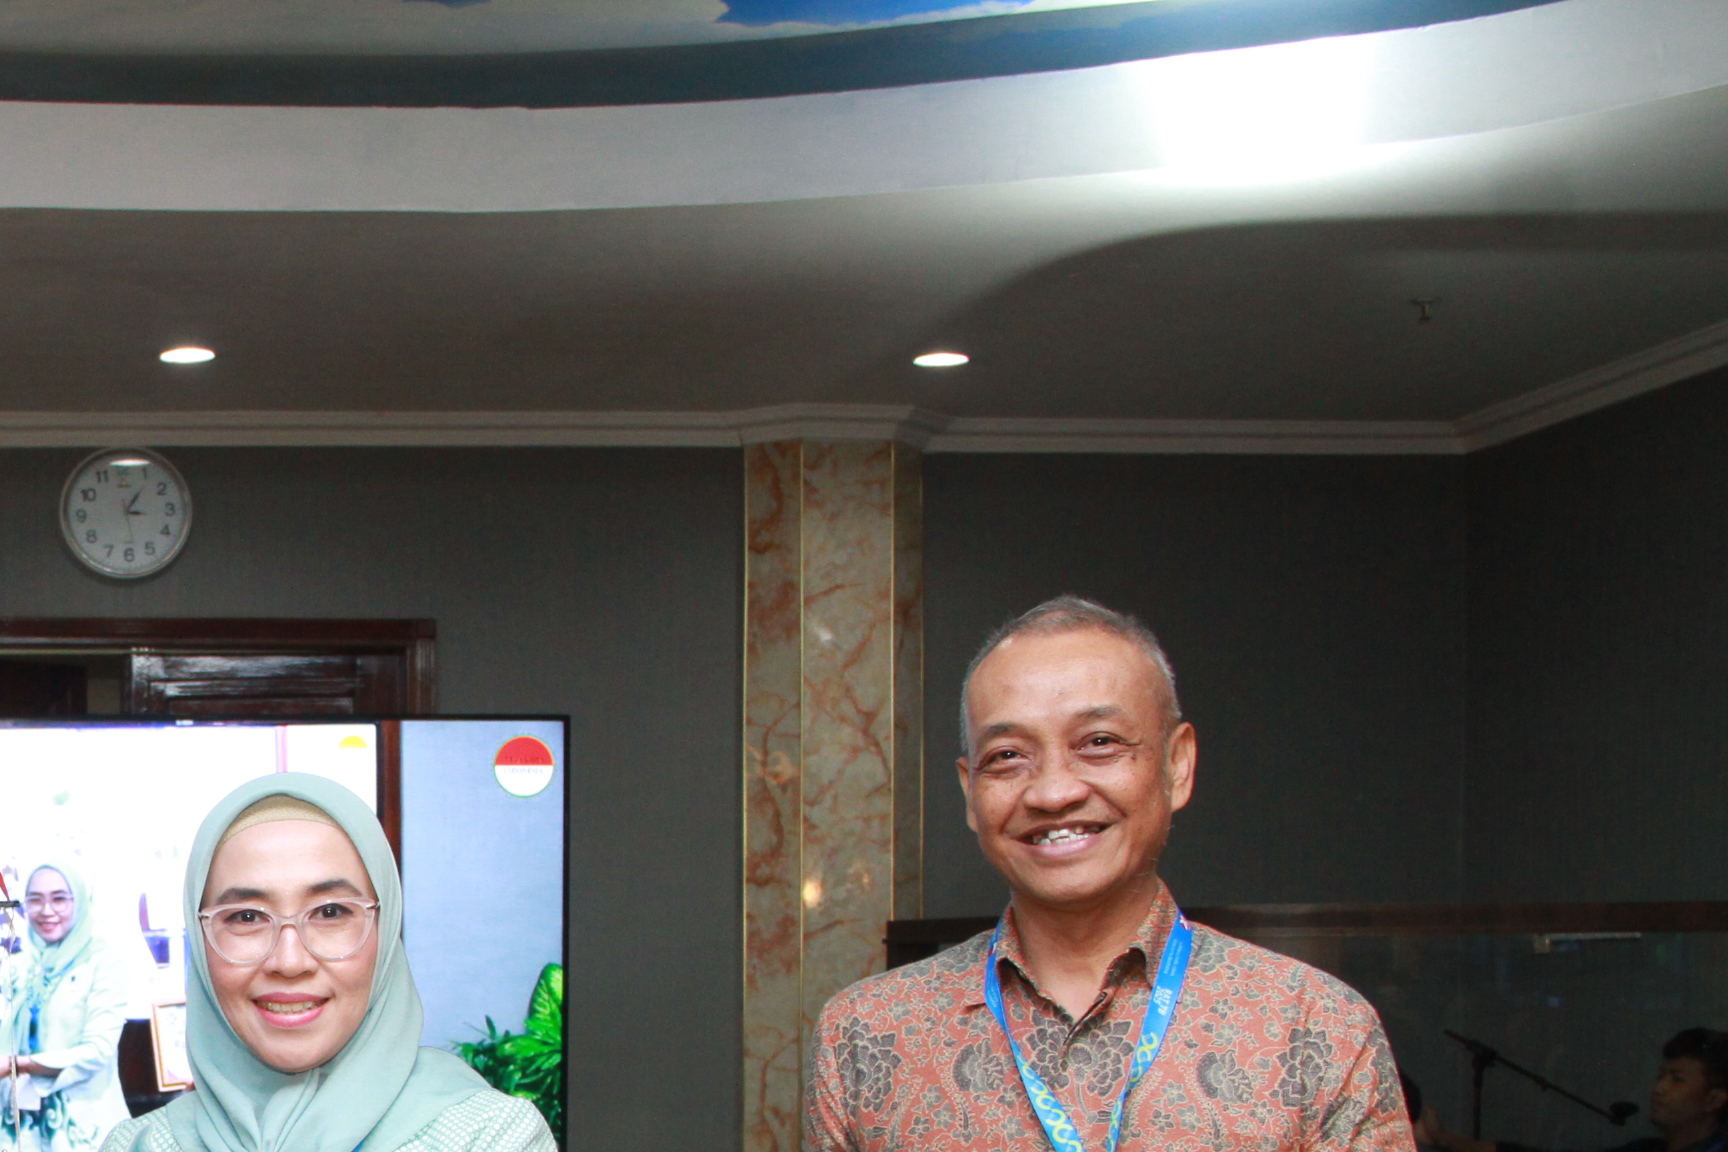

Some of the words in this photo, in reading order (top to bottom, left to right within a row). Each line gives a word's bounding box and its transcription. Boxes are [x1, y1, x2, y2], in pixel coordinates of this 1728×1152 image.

[95, 469, 109, 484] 11
[80, 487, 97, 502] 10
[156, 482, 168, 496] 2
[75, 509, 87, 523] 9
[165, 502, 176, 517] 3
[85, 529, 98, 543] 8
[160, 524, 172, 537] 4
[103, 544, 115, 558] 7
[123, 548, 135, 563] 6
[144, 541, 156, 556] 5
